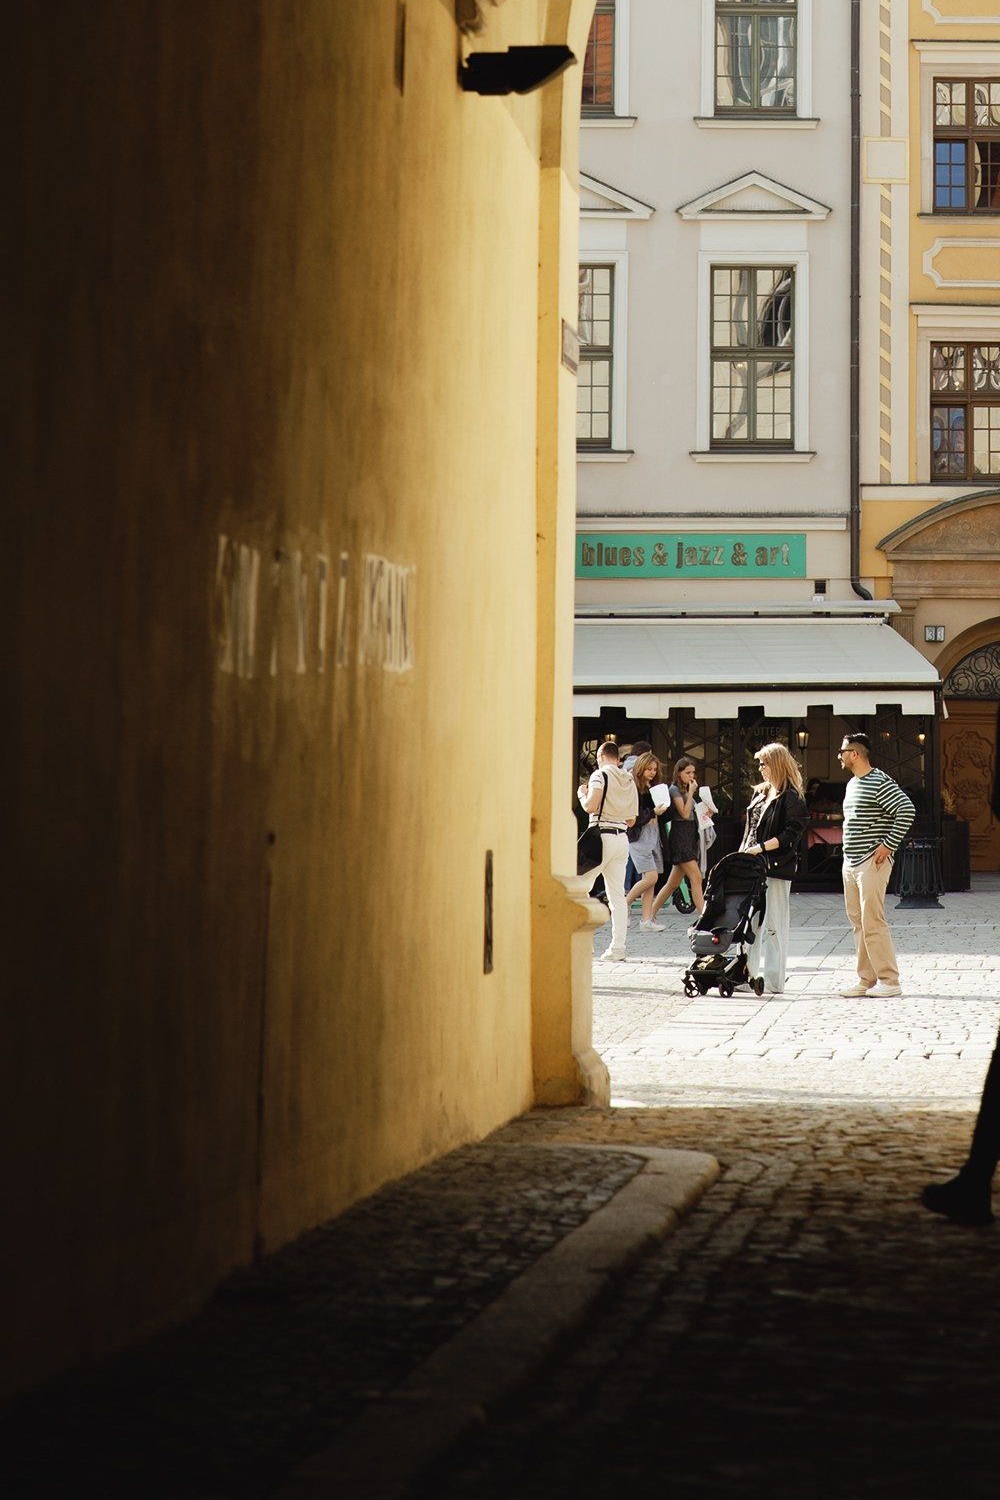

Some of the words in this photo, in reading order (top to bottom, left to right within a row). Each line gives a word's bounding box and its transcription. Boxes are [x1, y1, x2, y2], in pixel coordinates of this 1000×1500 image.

[581, 542, 646, 567] blues
[651, 542, 669, 567] &
[675, 541, 726, 569] jazz
[731, 542, 749, 567] &
[755, 542, 791, 567] art
